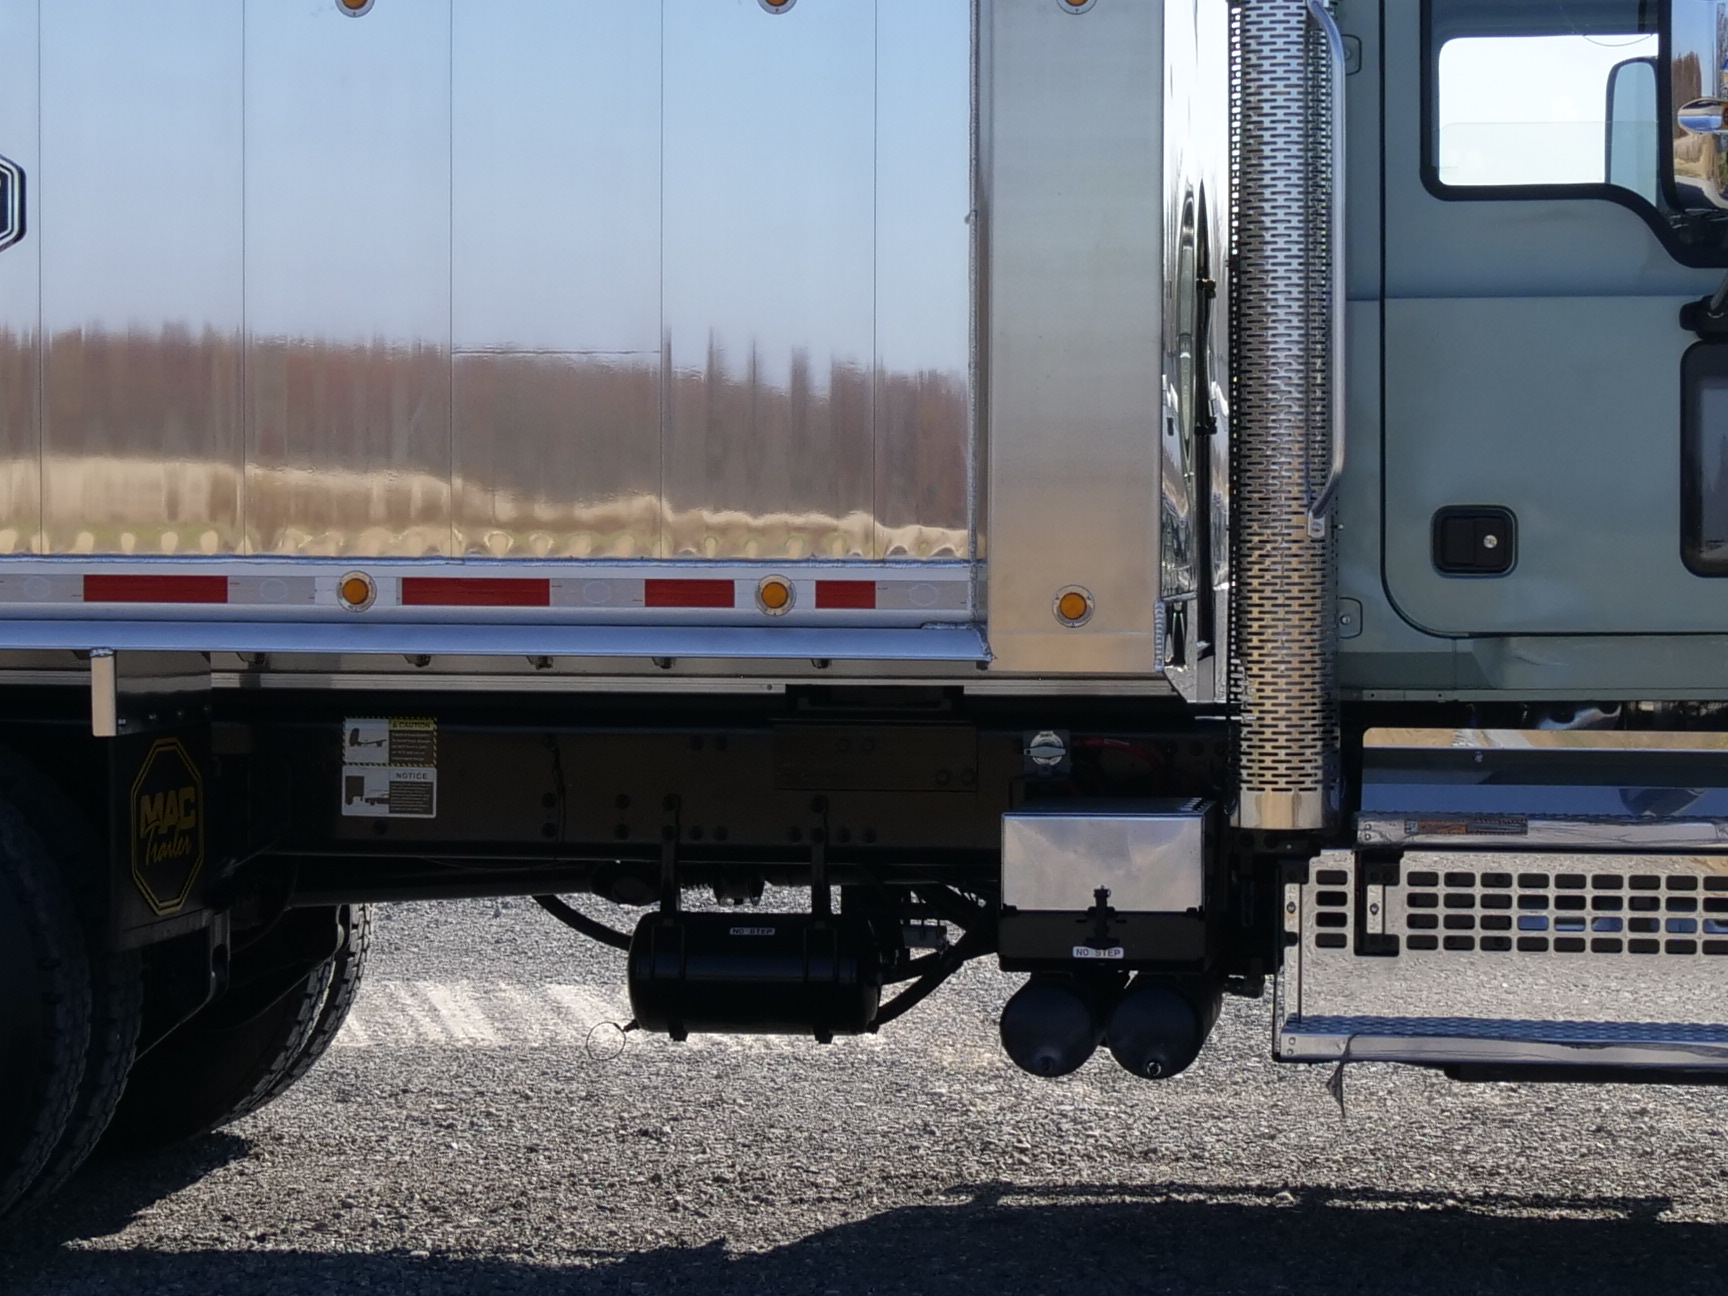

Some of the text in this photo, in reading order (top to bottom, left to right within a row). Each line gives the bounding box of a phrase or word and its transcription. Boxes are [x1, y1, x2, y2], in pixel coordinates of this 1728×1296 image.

[396, 772, 428, 780] NOTICE
[140, 785, 197, 839] MAC
[143, 821, 193, 867] Trailer
[1076, 948, 1121, 957] NO STEP
